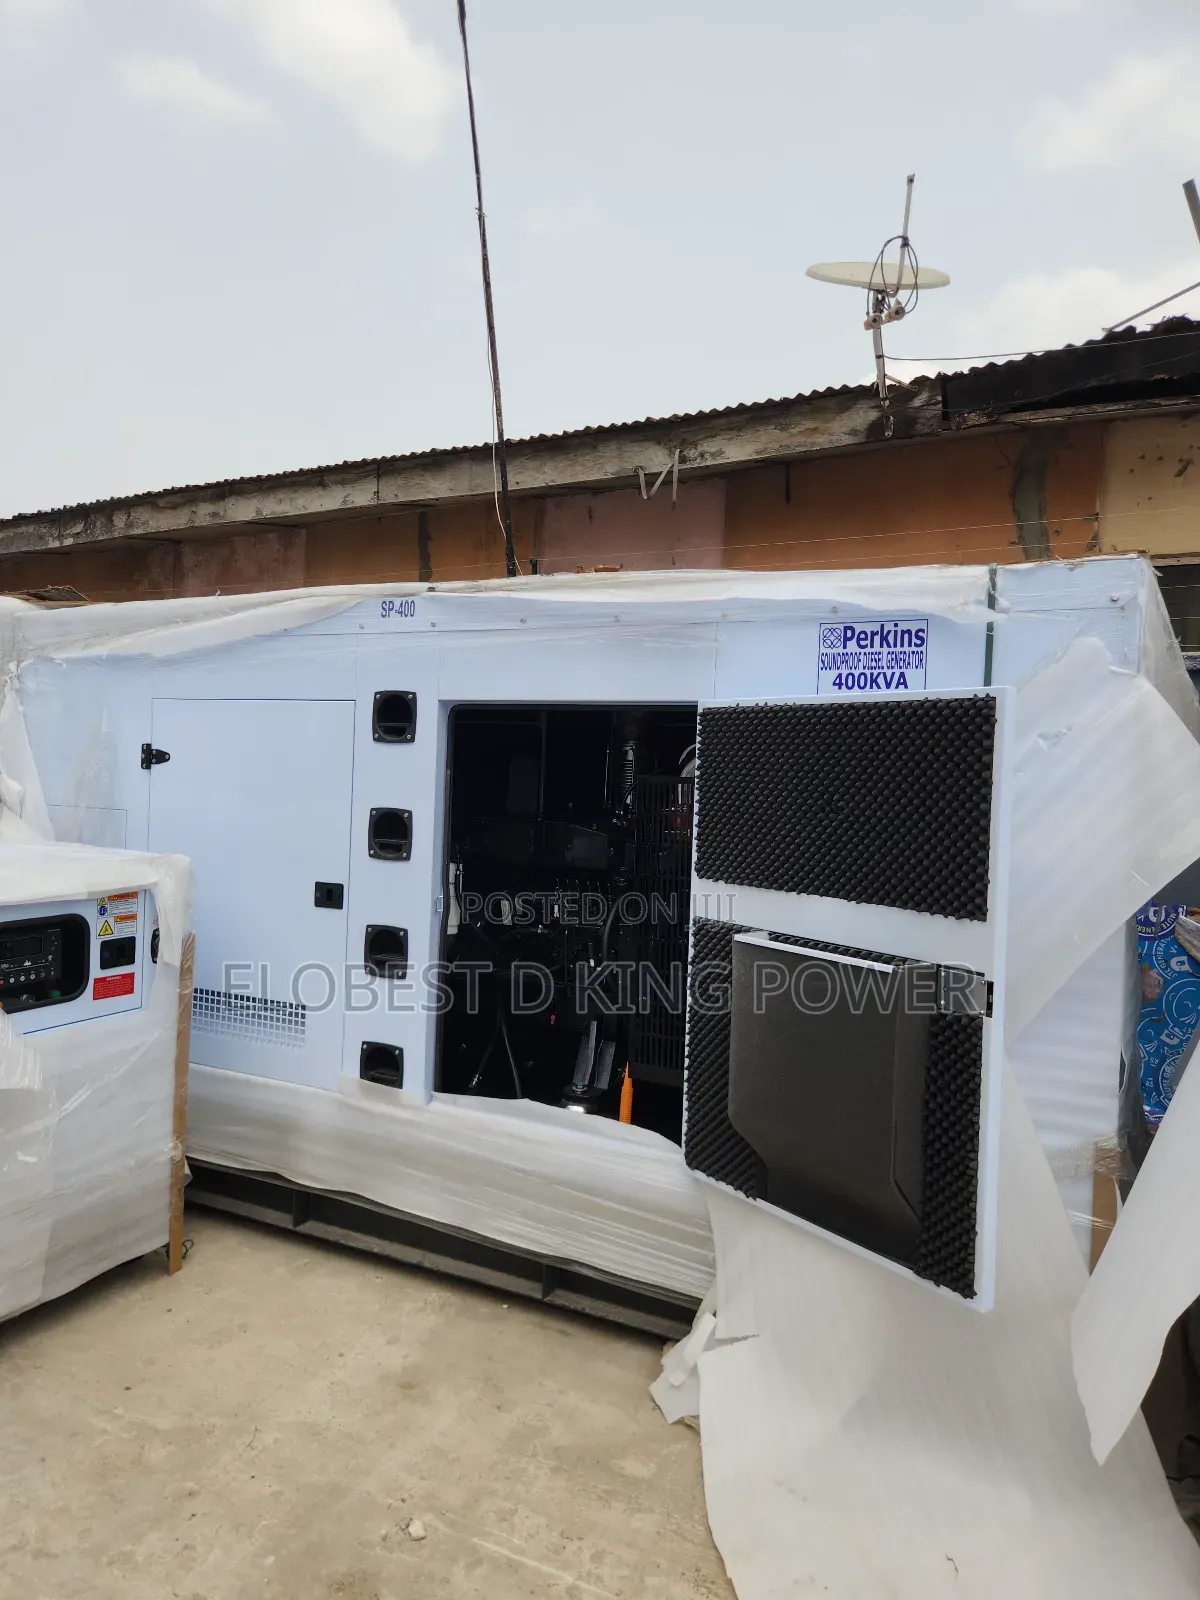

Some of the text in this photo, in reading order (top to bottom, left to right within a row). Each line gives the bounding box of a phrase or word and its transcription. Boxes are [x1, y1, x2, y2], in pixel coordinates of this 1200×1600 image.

[381, 600, 416, 618] SP-400
[842, 623, 926, 649] Perkins
[820, 650, 924, 670] SOUNDPROOF DIESEL GENERATOR
[832, 671, 909, 690] 400KVA
